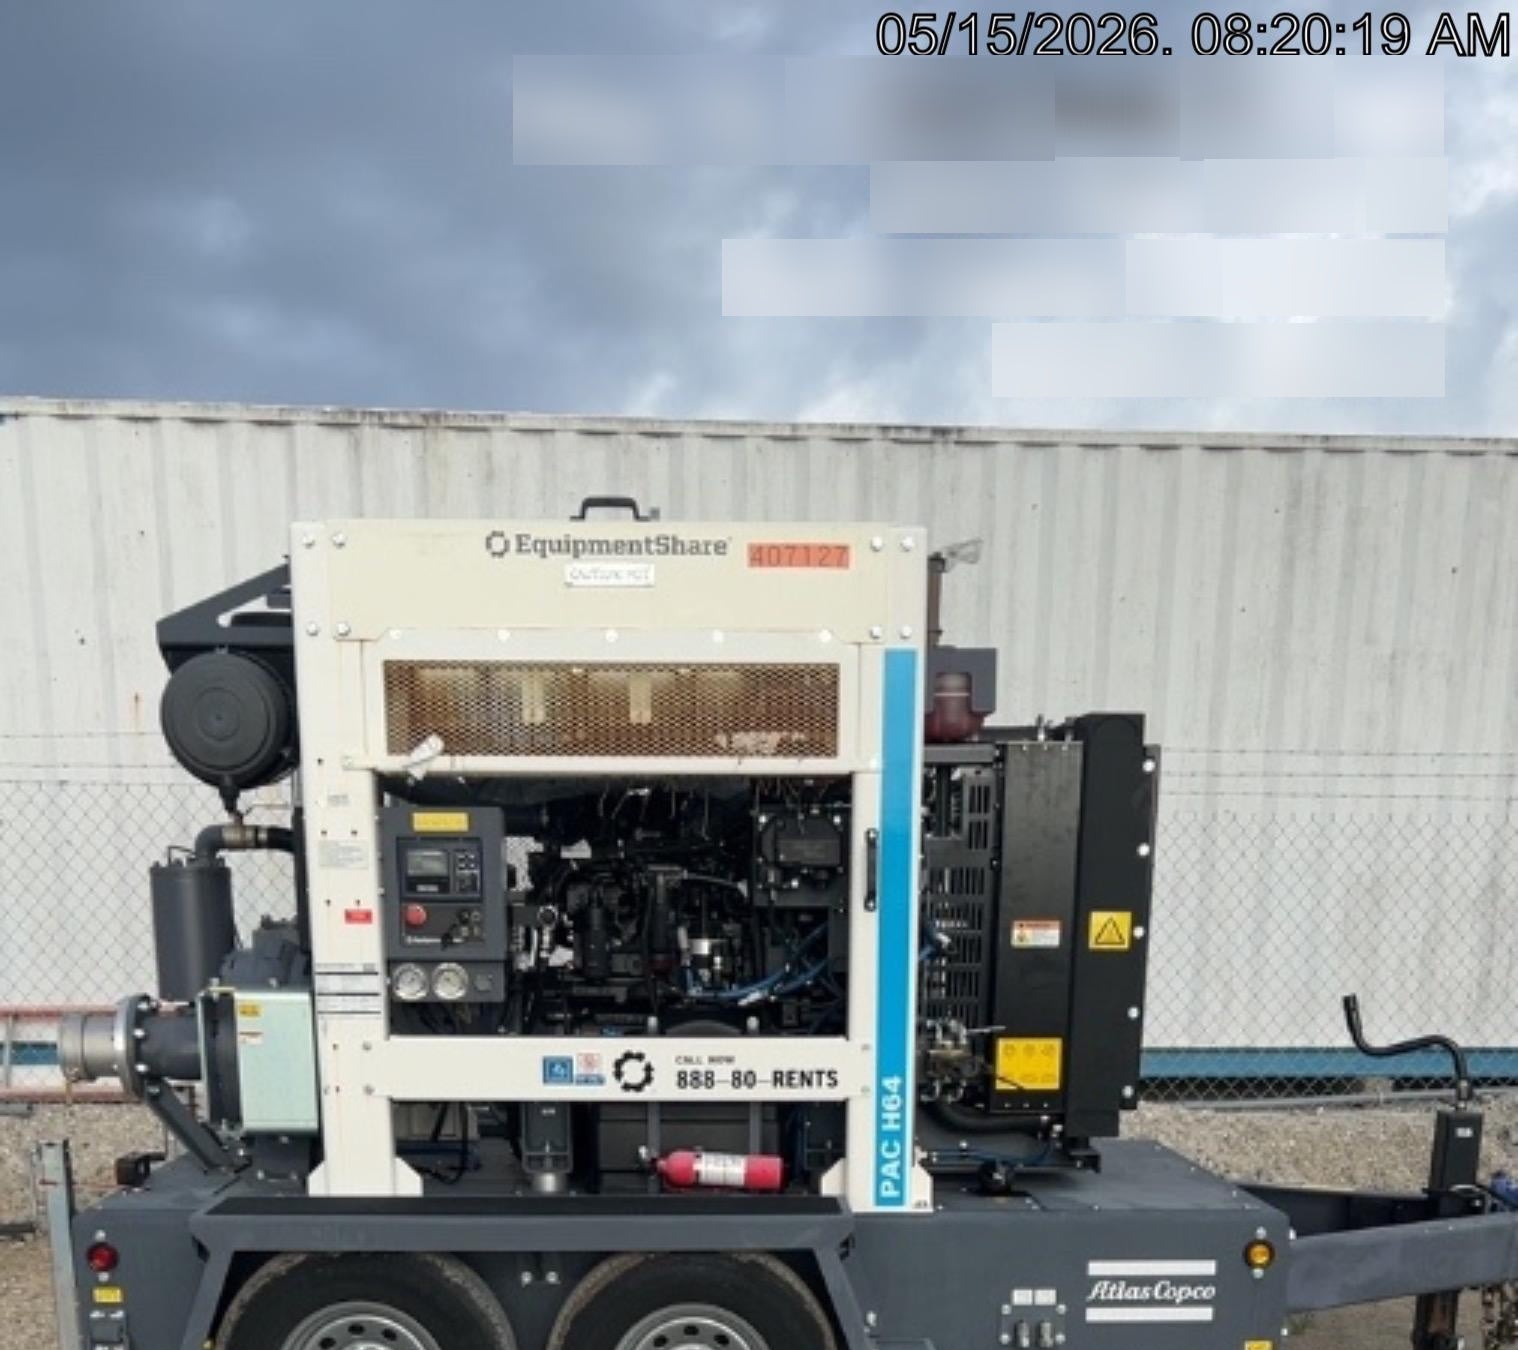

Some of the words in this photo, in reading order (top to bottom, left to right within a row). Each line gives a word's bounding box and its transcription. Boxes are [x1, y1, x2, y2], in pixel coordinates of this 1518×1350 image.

[514, 533, 729, 559] EquipmentShare
[749, 544, 849, 567] 407127
[880, 1075, 902, 1131] H64
[880, 1139, 901, 1198] PAC
[1087, 1280, 1151, 1302] Atlas
[1154, 1280, 1216, 1304] Copco
